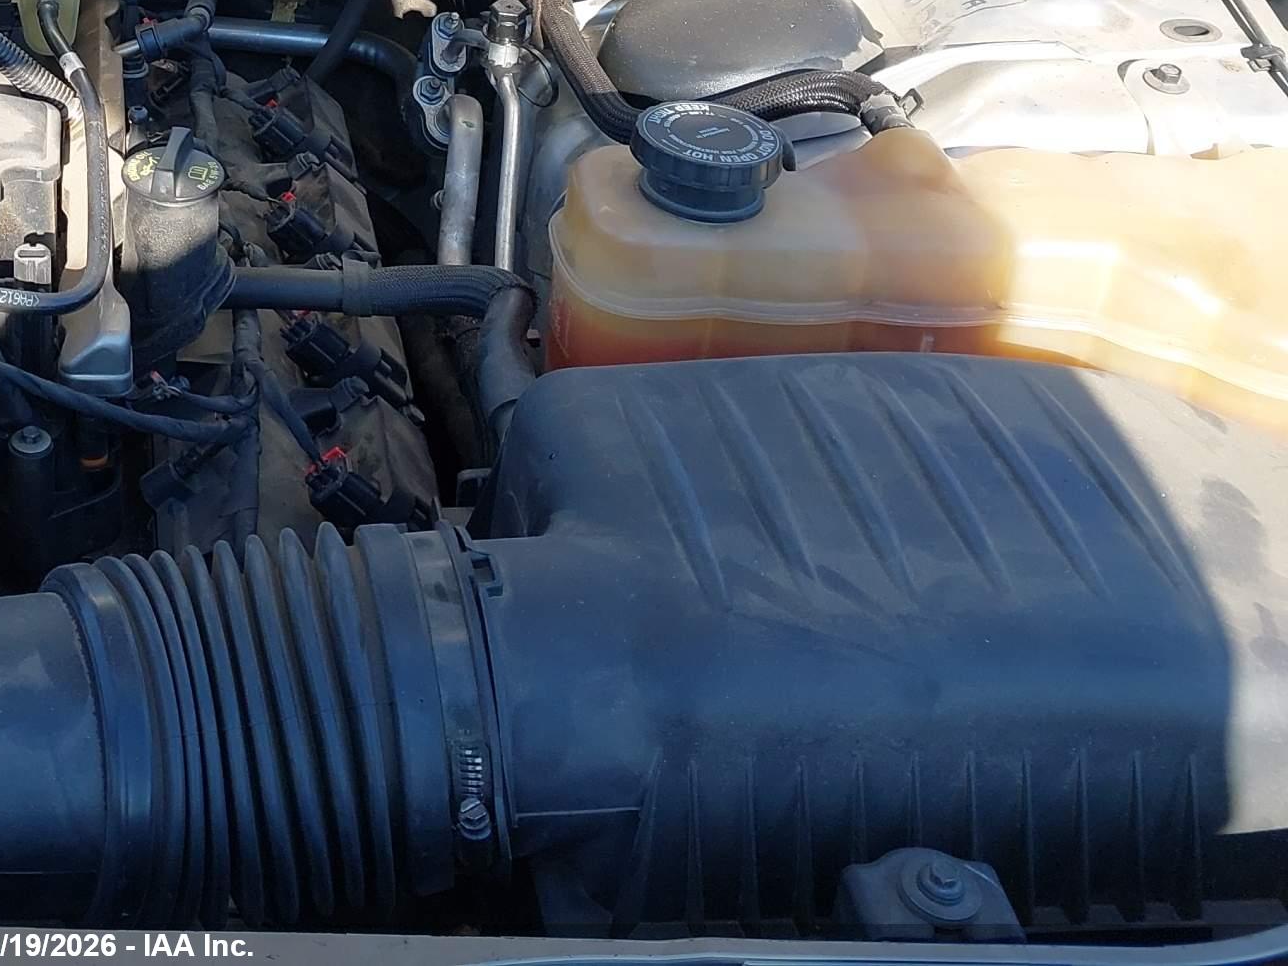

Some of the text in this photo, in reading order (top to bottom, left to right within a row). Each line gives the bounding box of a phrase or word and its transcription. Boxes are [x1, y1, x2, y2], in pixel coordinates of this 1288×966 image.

[674, 103, 710, 113] KEEP
[648, 108, 675, 124] TIGHT
[759, 129, 775, 141] DO
[681, 149, 713, 161] HOT
[758, 141, 775, 157] NOT
[135, 151, 153, 160] OIL
[719, 152, 759, 163] OPEN
